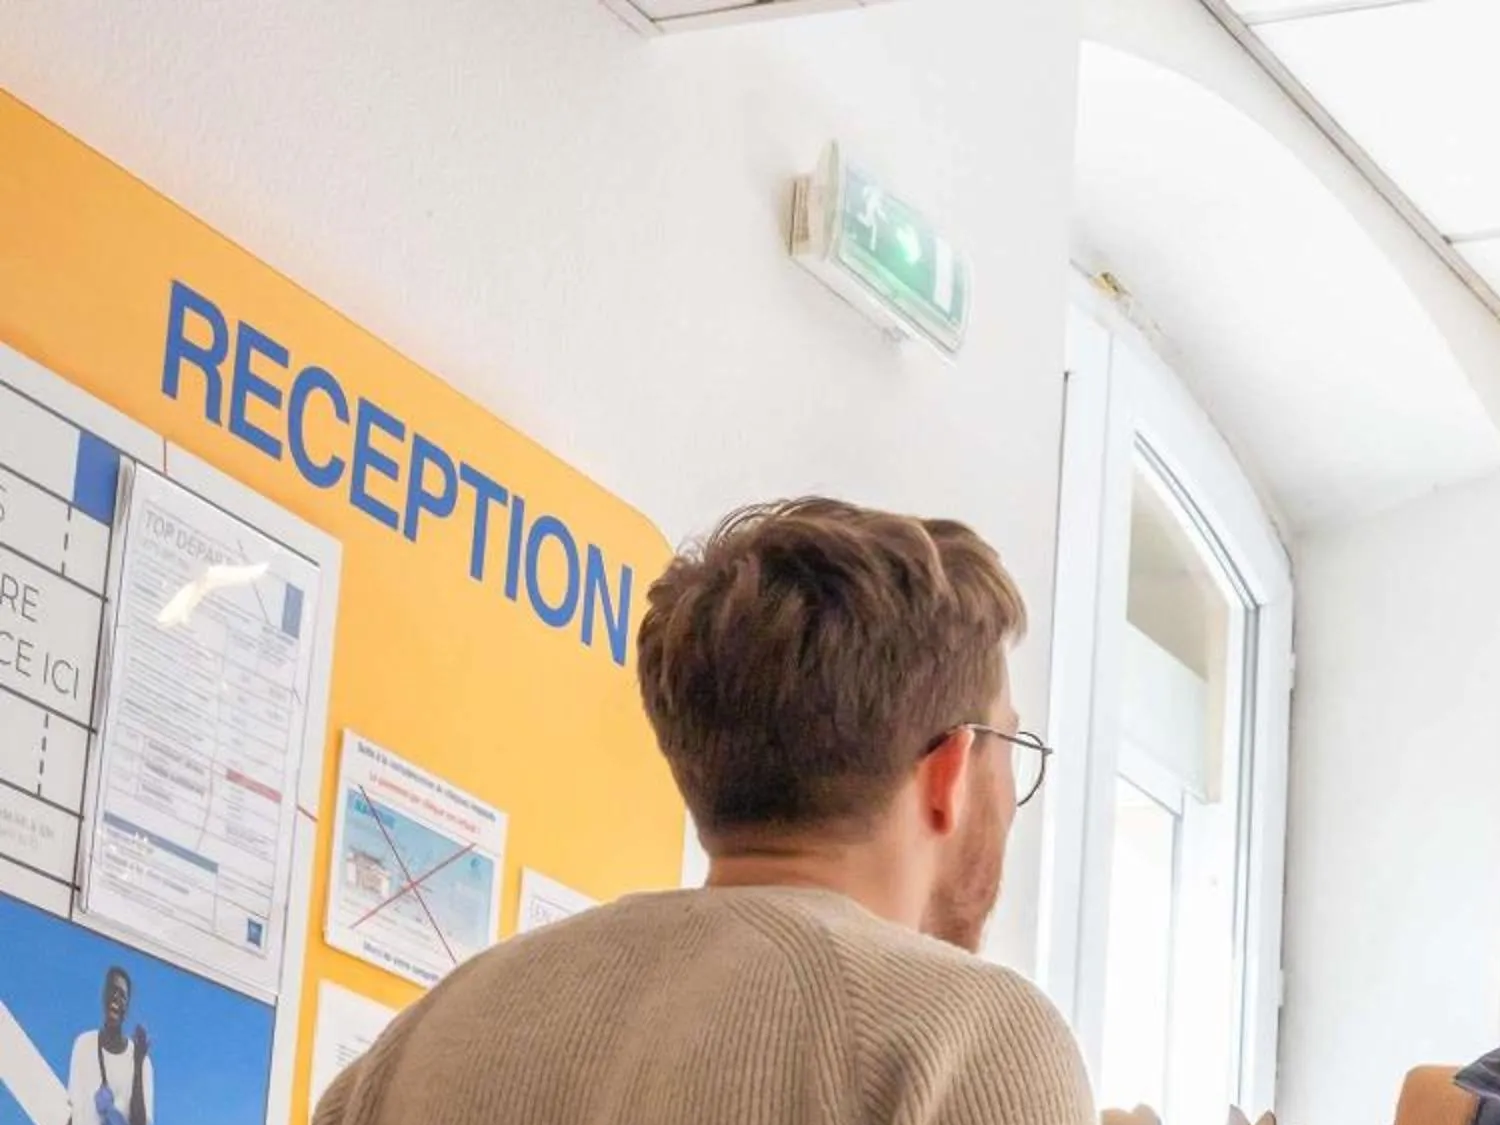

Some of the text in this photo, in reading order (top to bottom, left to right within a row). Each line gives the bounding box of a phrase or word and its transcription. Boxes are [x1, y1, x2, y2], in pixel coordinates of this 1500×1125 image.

[161, 278, 633, 667] RECEPTION
[145, 508, 174, 545] TOP
[43, 651, 79, 701] ICI
